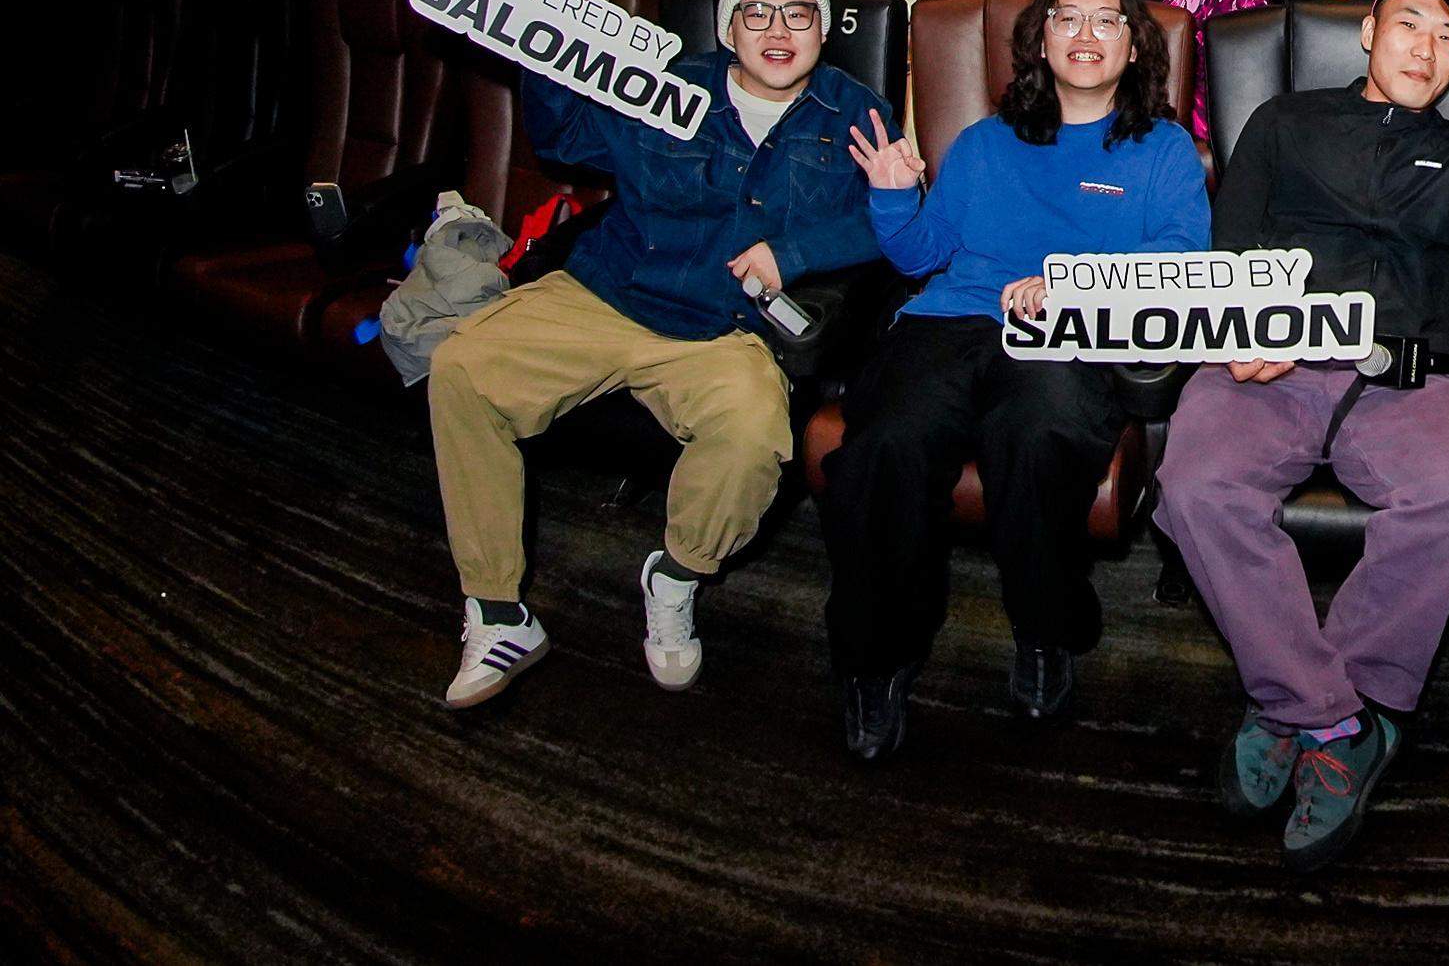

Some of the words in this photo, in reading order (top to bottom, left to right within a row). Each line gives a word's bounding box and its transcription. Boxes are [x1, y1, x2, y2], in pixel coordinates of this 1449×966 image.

[840, 8, 859, 34] 5
[629, 25, 674, 60] BY
[1047, 261, 1234, 290] POWERED
[1248, 258, 1299, 287] BY
[1005, 302, 1364, 350] SALOMON
